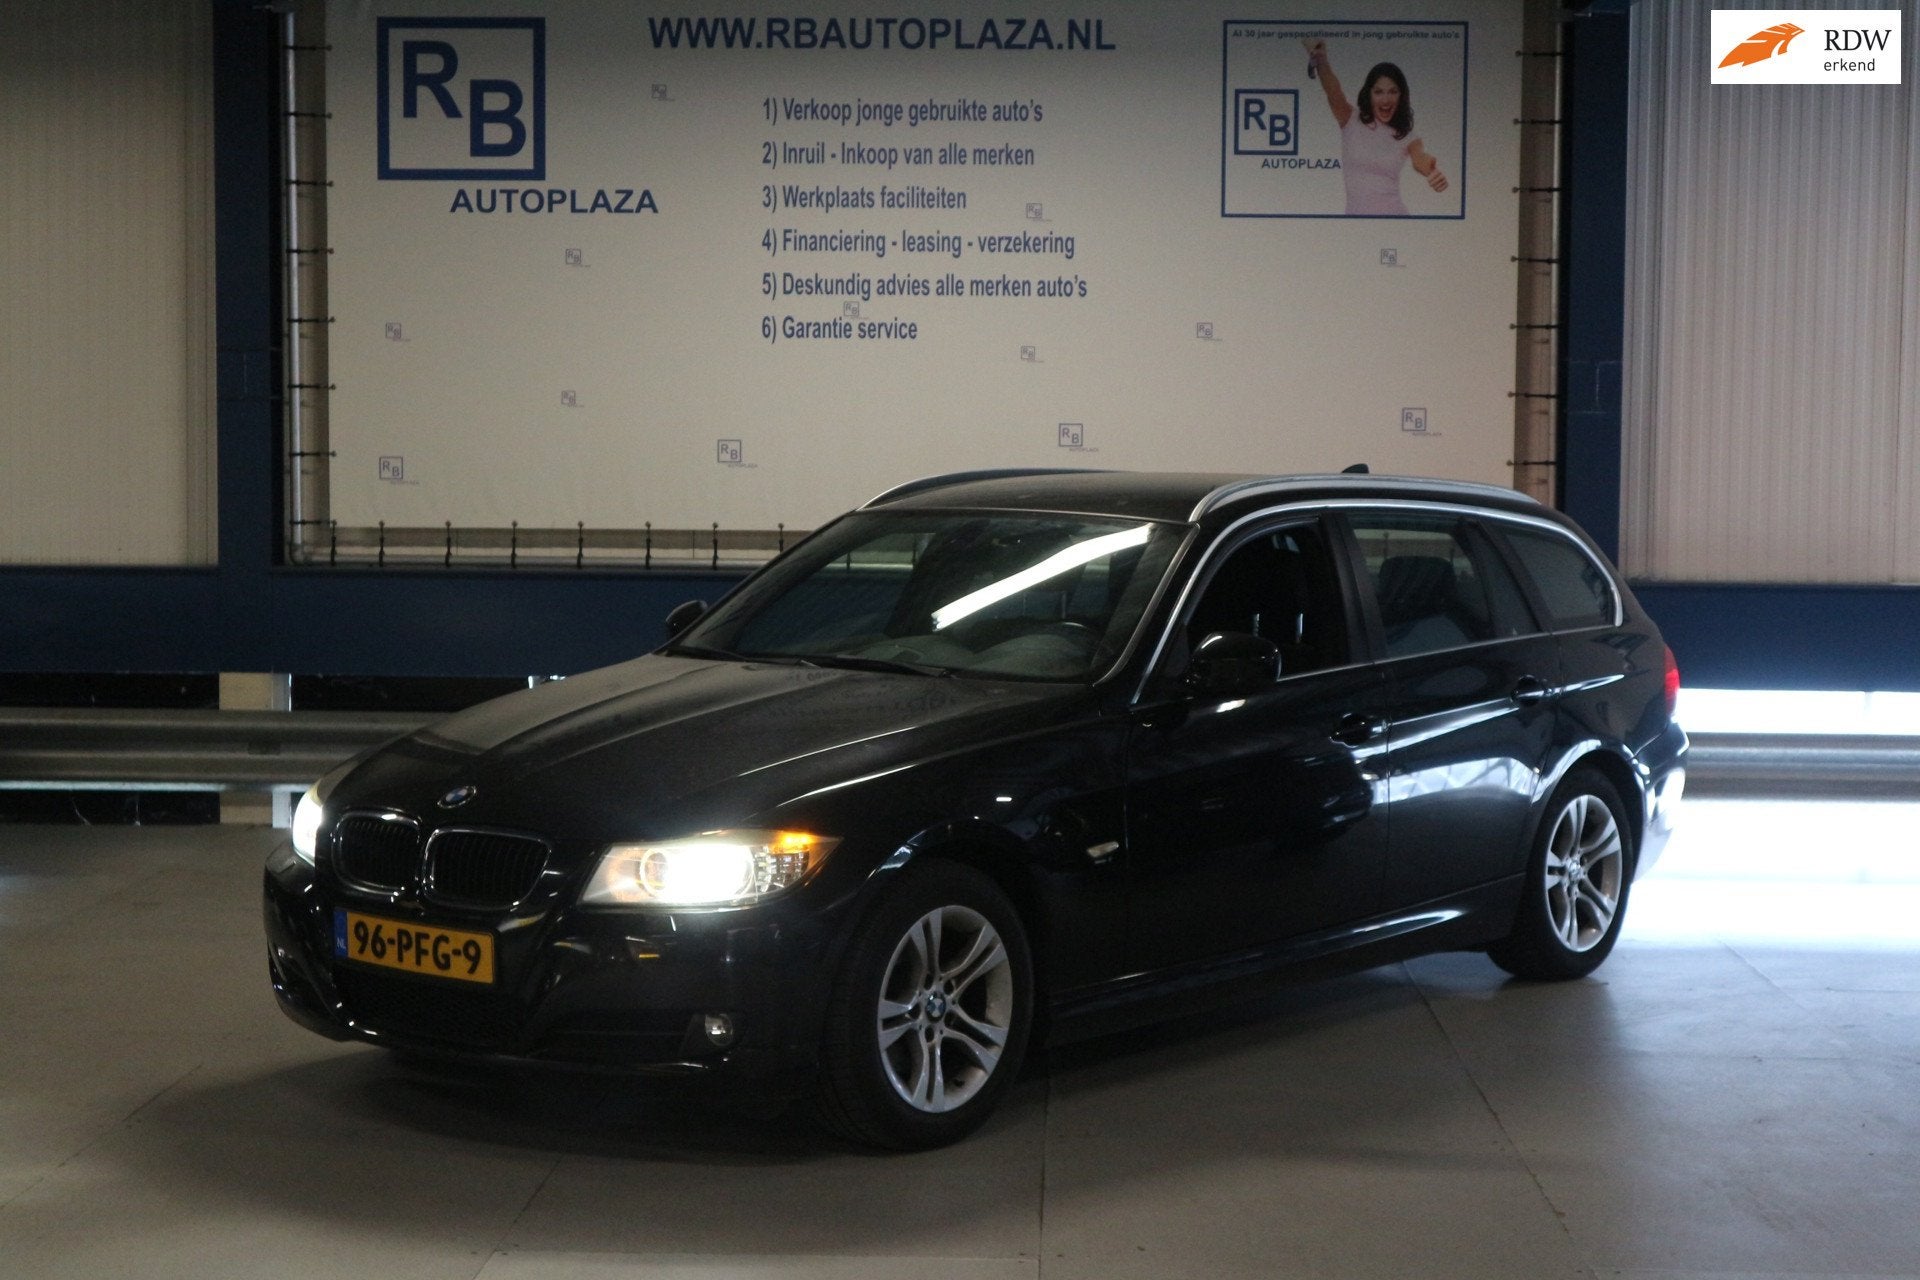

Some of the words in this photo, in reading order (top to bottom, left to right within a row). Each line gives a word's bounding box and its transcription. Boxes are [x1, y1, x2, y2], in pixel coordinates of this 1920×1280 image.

[648, 17, 1116, 51] WWW.RBAUTOPLAZA.NL
[1257, 30, 1275, 40] jaar
[1363, 31, 1384, 41] jong
[1386, 31, 1430, 41] gebruikte
[402, 39, 527, 157] RB
[763, 97, 778, 121] 1)
[782, 97, 853, 125] Verkoop
[855, 98, 904, 127] jonge
[908, 98, 988, 127] gebruikte
[992, 98, 1044, 122] auto's
[1244, 98, 1292, 146] RB
[762, 141, 778, 166] 2)
[782, 141, 826, 165] Inruil
[840, 141, 899, 169] Inkoop
[903, 147, 933, 165] van
[938, 142, 968, 165] alle
[972, 143, 1035, 166] merken
[1261, 158, 1342, 170] AUTOPLAZA
[450, 188, 659, 214] AUTOPLAZA
[762, 185, 778, 209] 3)
[782, 185, 875, 213] Werkplaats
[880, 185, 967, 209] faciliteiten
[762, 229, 778, 252] 4)
[782, 229, 886, 258] Financiering
[902, 229, 962, 259] leasing
[977, 230, 1075, 259] verzekering
[762, 273, 778, 296] 5)
[782, 273, 871, 301] Deskundig
[876, 273, 931, 297] advies
[935, 273, 965, 297] alle
[969, 274, 1032, 298] merken
[1036, 275, 1088, 298] auto's
[762, 316, 777, 340] 6)
[782, 316, 853, 339] Garantie
[857, 317, 918, 340] service
[353, 919, 482, 975] 96-PFG-9
